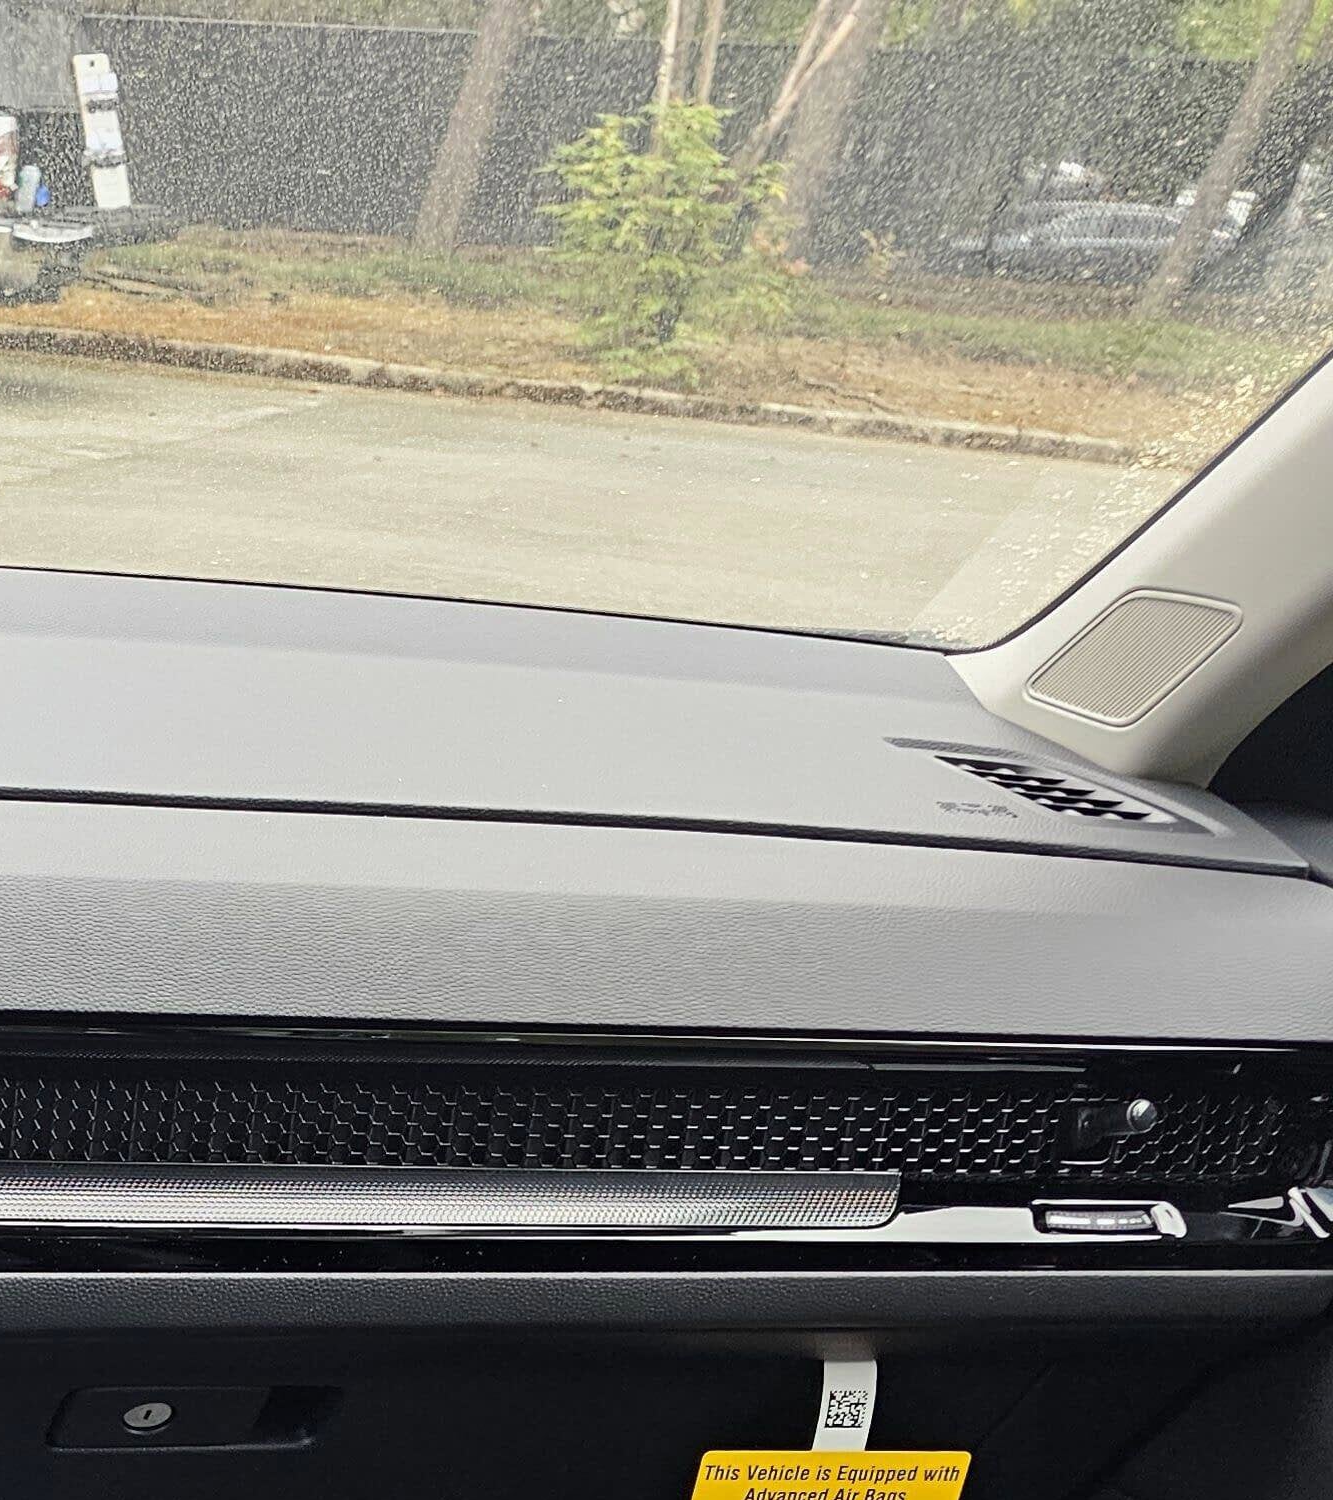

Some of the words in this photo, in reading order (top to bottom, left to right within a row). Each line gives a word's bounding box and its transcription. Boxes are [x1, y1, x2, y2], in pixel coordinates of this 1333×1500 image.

[705, 1465, 740, 1480] This
[747, 1465, 810, 1480] Vehicle
[816, 1465, 831, 1480] is
[837, 1466, 918, 1484] Equipped
[924, 1466, 960, 1481] with
